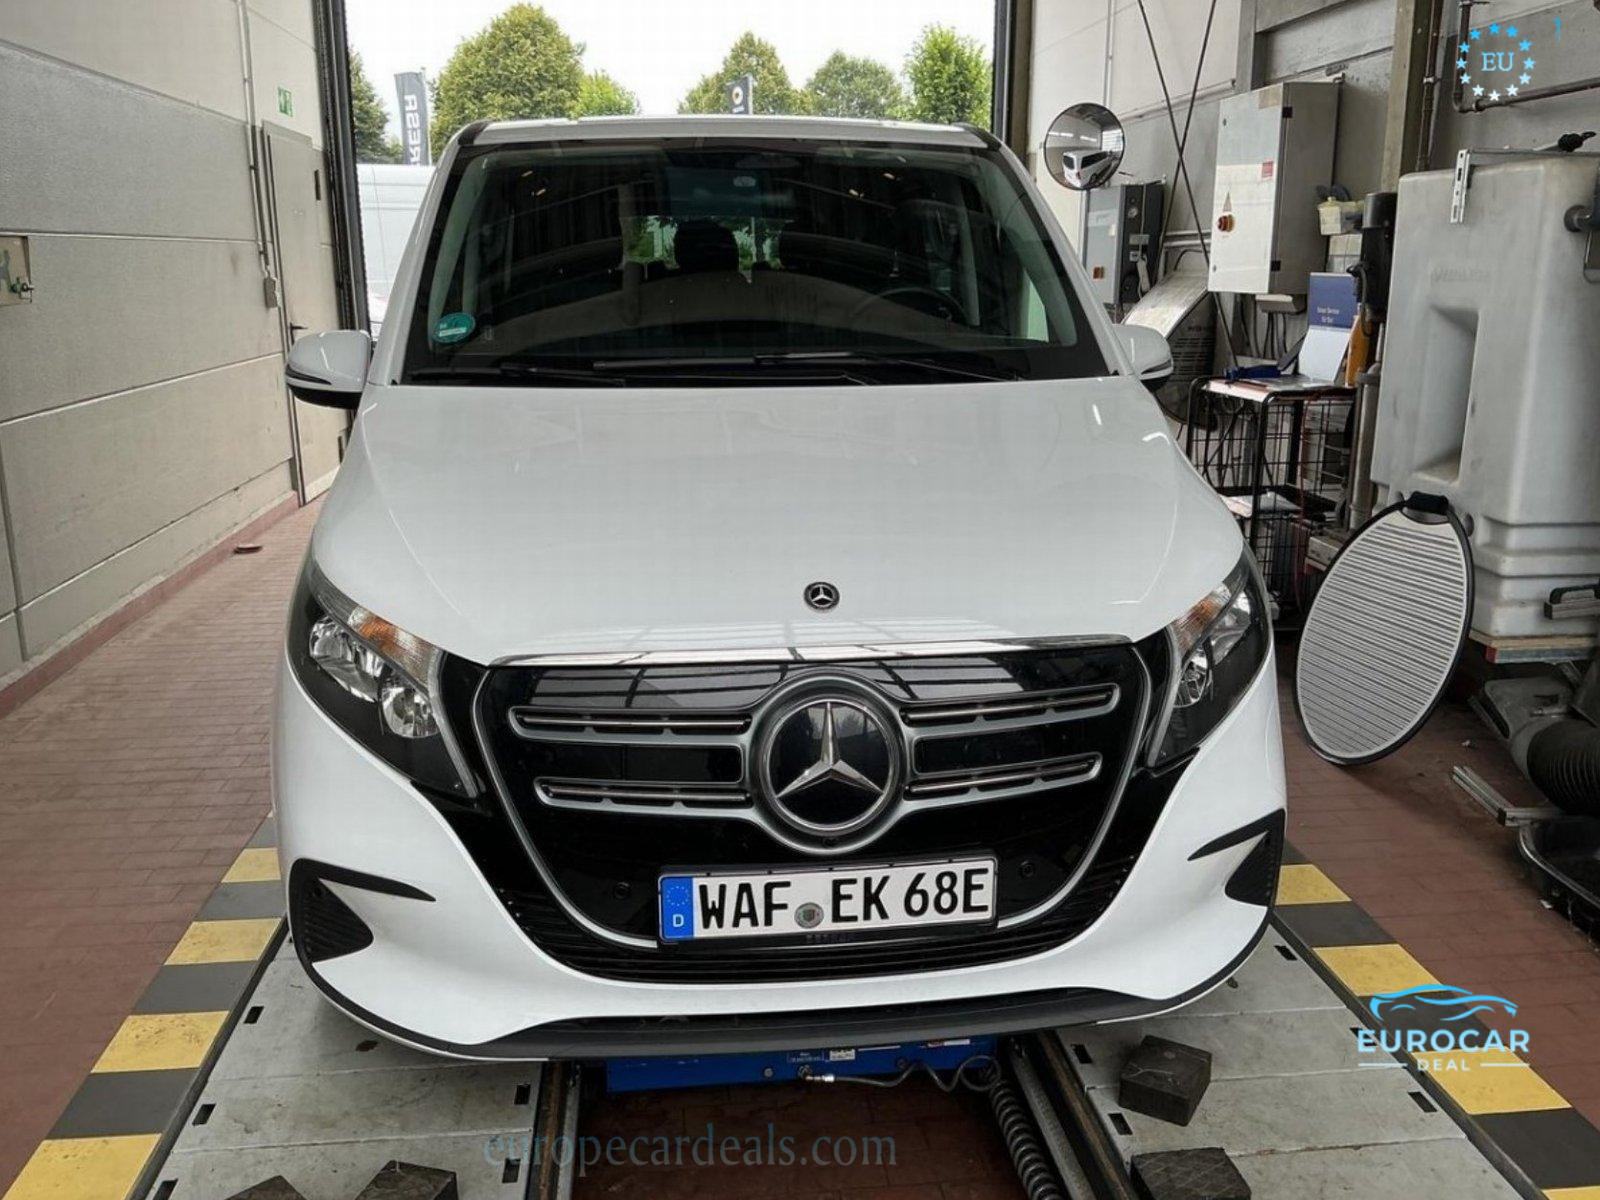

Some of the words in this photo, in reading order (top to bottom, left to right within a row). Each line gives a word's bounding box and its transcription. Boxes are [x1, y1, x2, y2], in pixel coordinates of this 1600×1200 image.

[699, 881, 791, 929] WAF
[832, 875, 890, 923] EK
[904, 868, 989, 917] 68E
[673, 914, 684, 927] D
